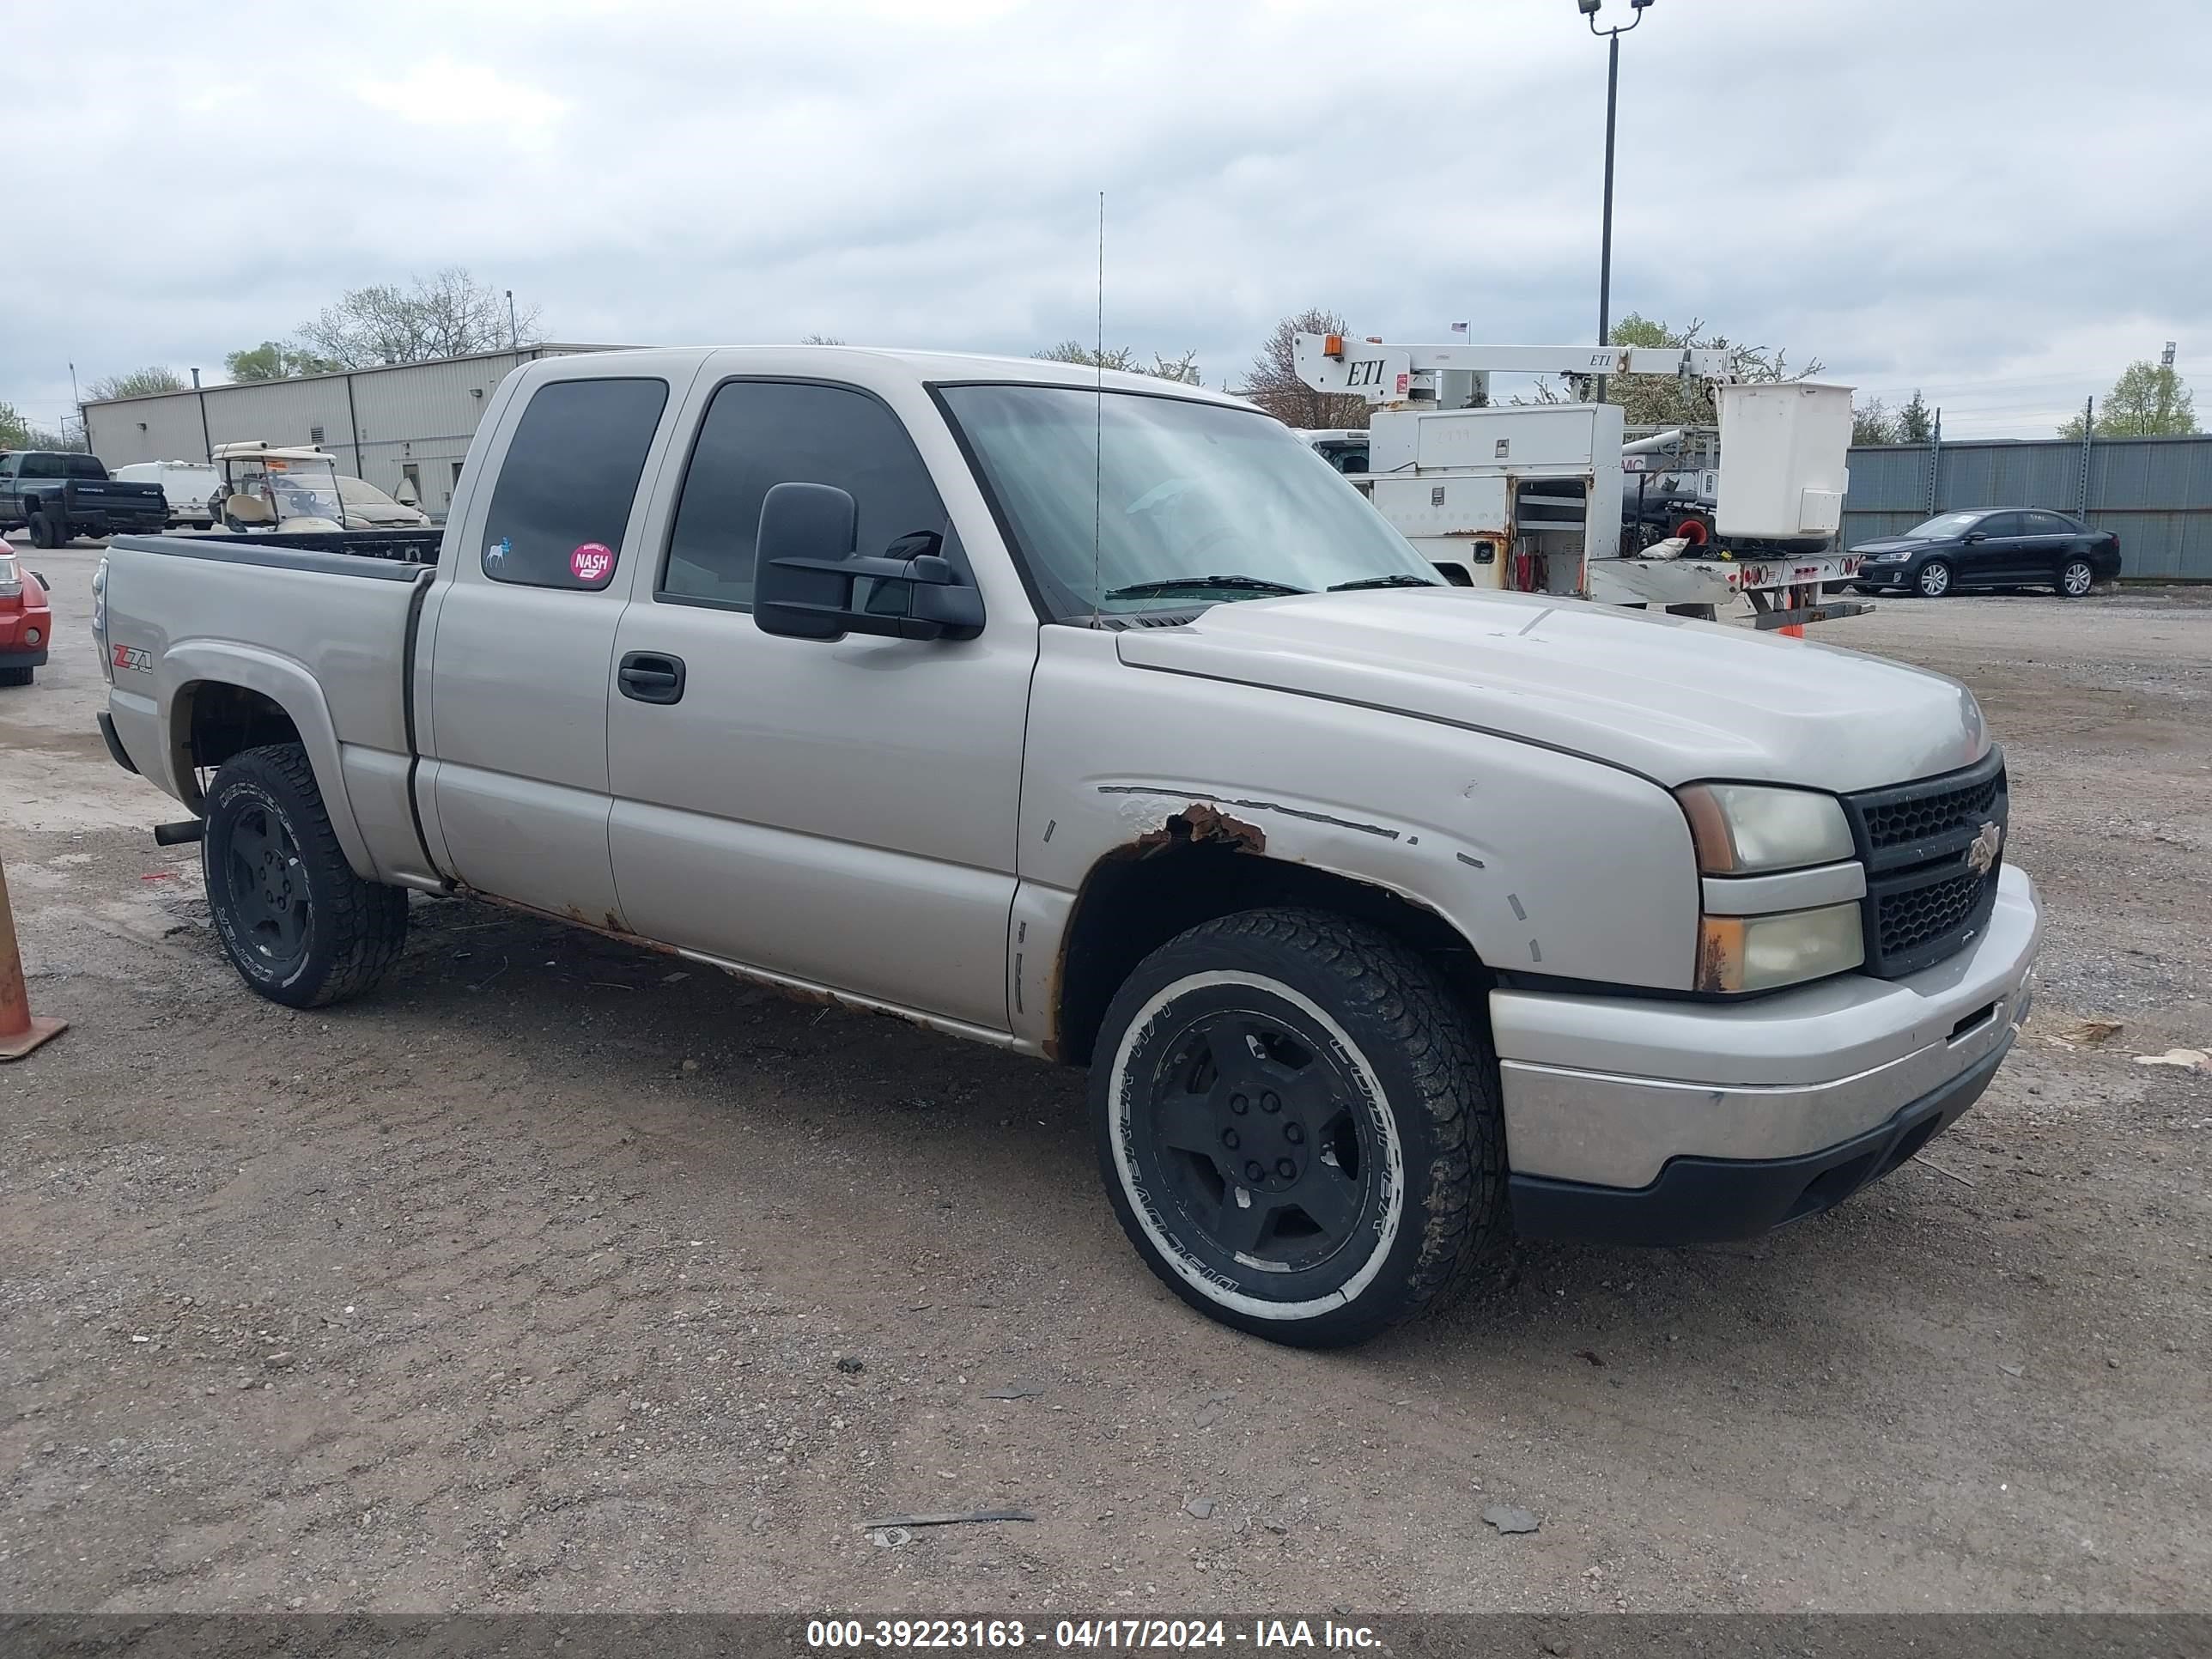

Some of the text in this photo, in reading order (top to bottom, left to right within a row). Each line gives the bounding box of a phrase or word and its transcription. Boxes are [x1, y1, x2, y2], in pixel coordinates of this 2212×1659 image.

[1589, 355, 1611, 366] ETI
[1346, 360, 1387, 386] ETI
[575, 554, 609, 570] NASH
[113, 644, 152, 669] Z71
